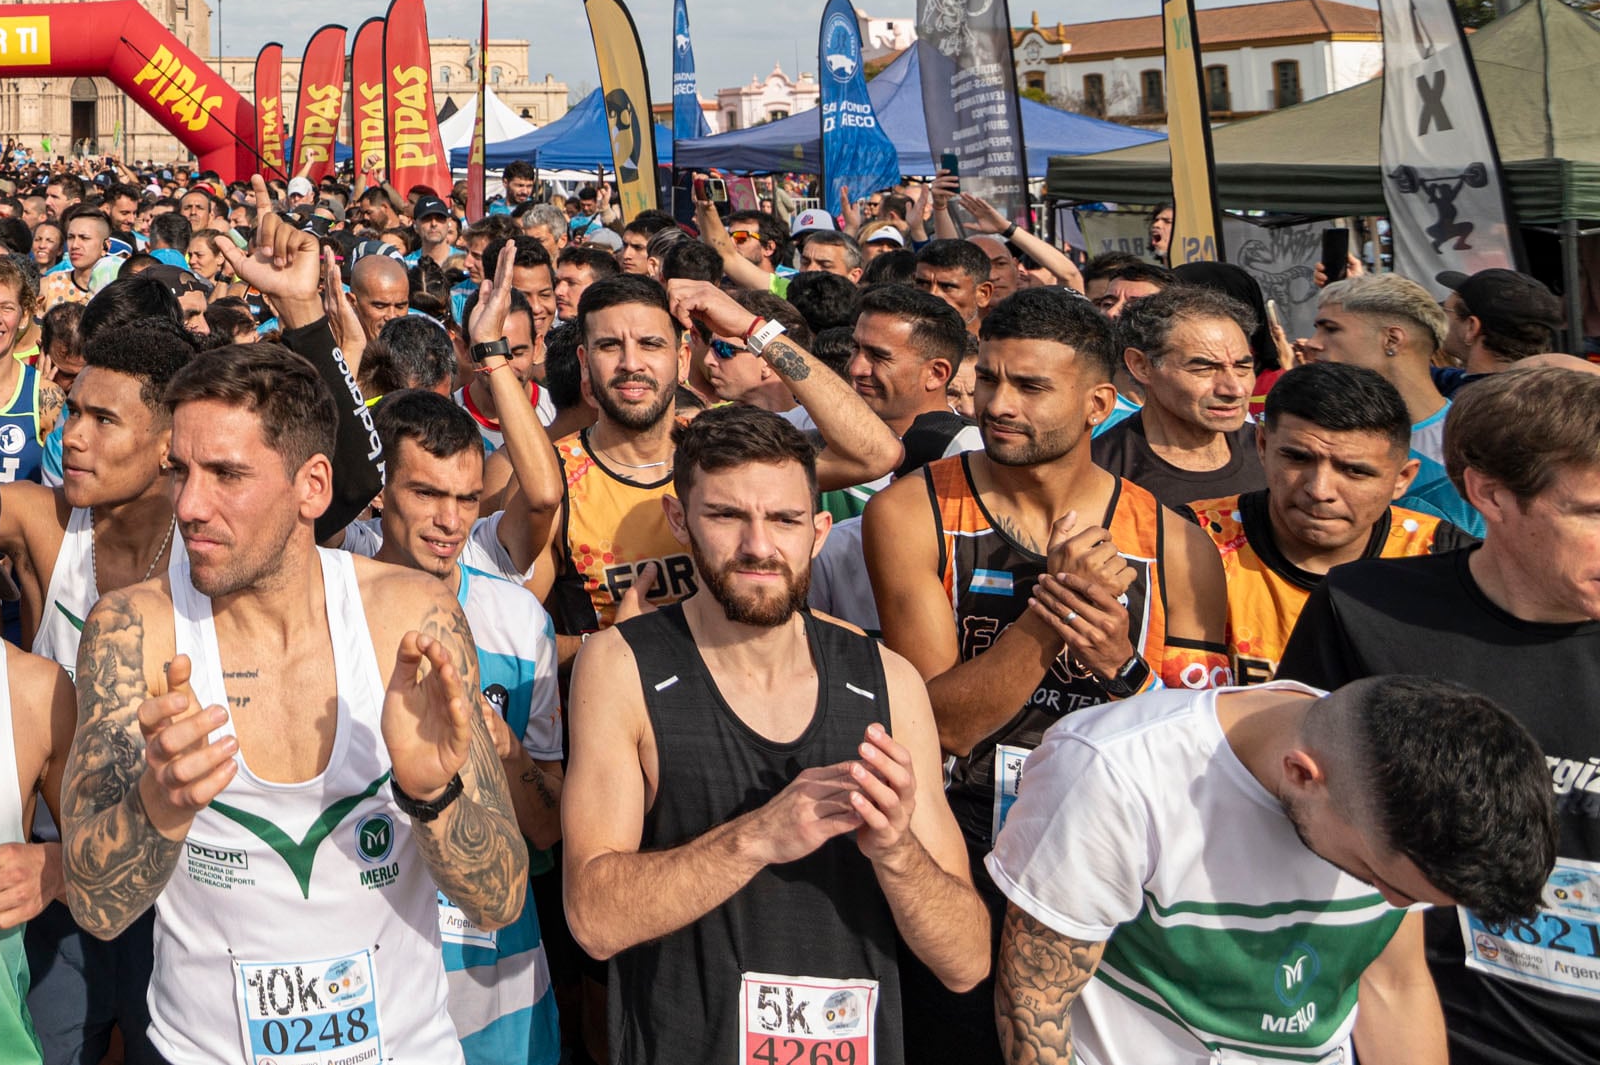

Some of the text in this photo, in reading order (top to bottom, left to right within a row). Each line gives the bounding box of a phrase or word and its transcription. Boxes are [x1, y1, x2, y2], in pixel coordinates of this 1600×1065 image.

[16, 27, 38, 54] TI
[134, 44, 223, 131] PIPAS
[300, 83, 342, 165] PIPAS
[392, 64, 438, 169] PIPAS
[332, 347, 383, 461] balance
[188, 859, 225, 874] SECRETARIA
[193, 875, 231, 890] RECREACION
[225, 876, 256, 886] DEPORTE
[360, 862, 399, 885] MERLO
[447, 915, 476, 928] Argen
[248, 966, 326, 1017] 10k
[757, 985, 813, 1034] 5k
[263, 1007, 369, 1055] 0248
[753, 1037, 856, 1065] 4269
